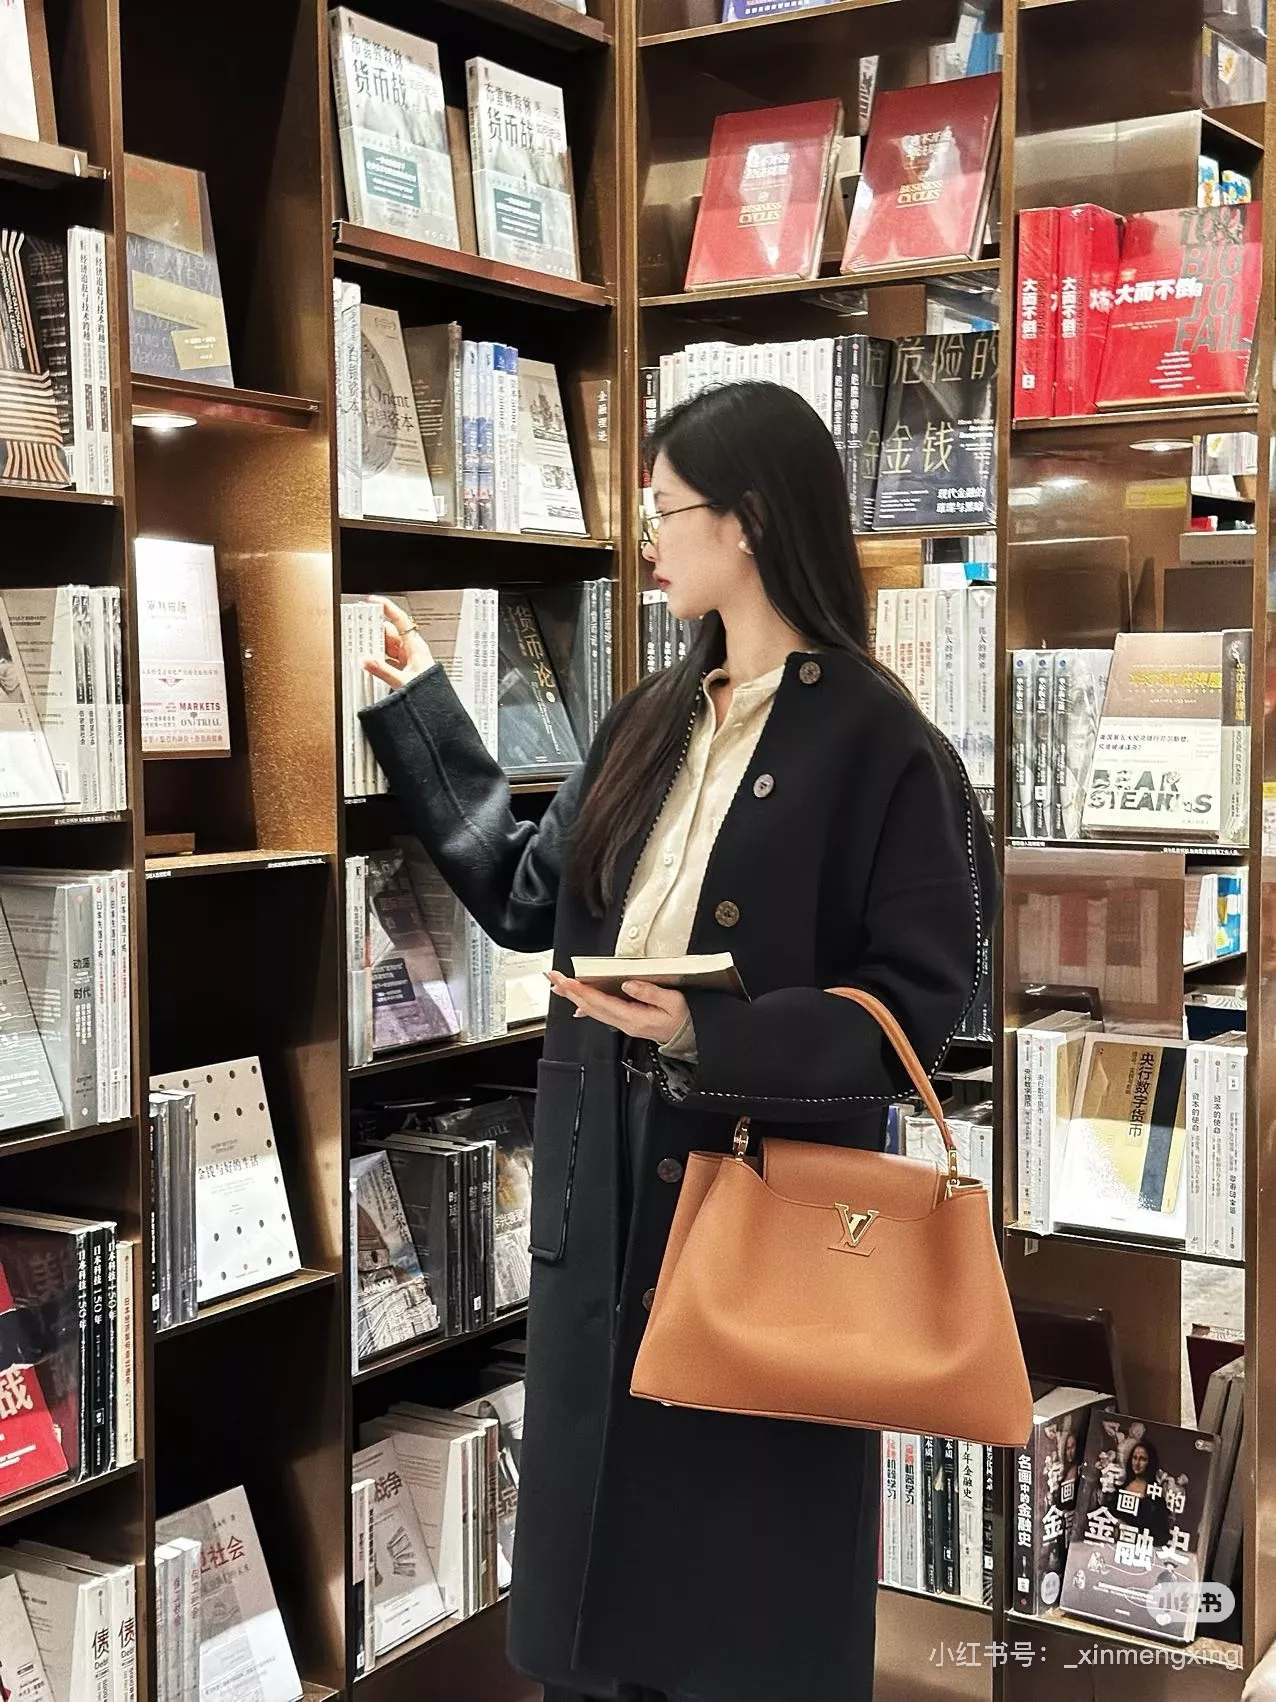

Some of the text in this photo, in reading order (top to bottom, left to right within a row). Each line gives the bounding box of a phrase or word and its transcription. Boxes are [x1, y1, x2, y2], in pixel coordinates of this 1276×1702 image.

[1181, 245, 1242, 279] BIG
[1021, 277, 1039, 341] 大而不倒
[1061, 276, 1079, 339] 大而不倒
[1173, 315, 1252, 353] FAIL
[880, 419, 956, 474] 金钱
[179, 702, 221, 712] MARKETS
[195, 718, 222, 727] TRIAL
[1128, 1051, 1155, 1138] 央行数字货币
[93, 1244, 102, 1325] 日本科技150年
[1017, 1453, 1032, 1548] 名画中的金融史
[1083, 1505, 1191, 1572] 金融史
[91, 1627, 110, 1661] 债
